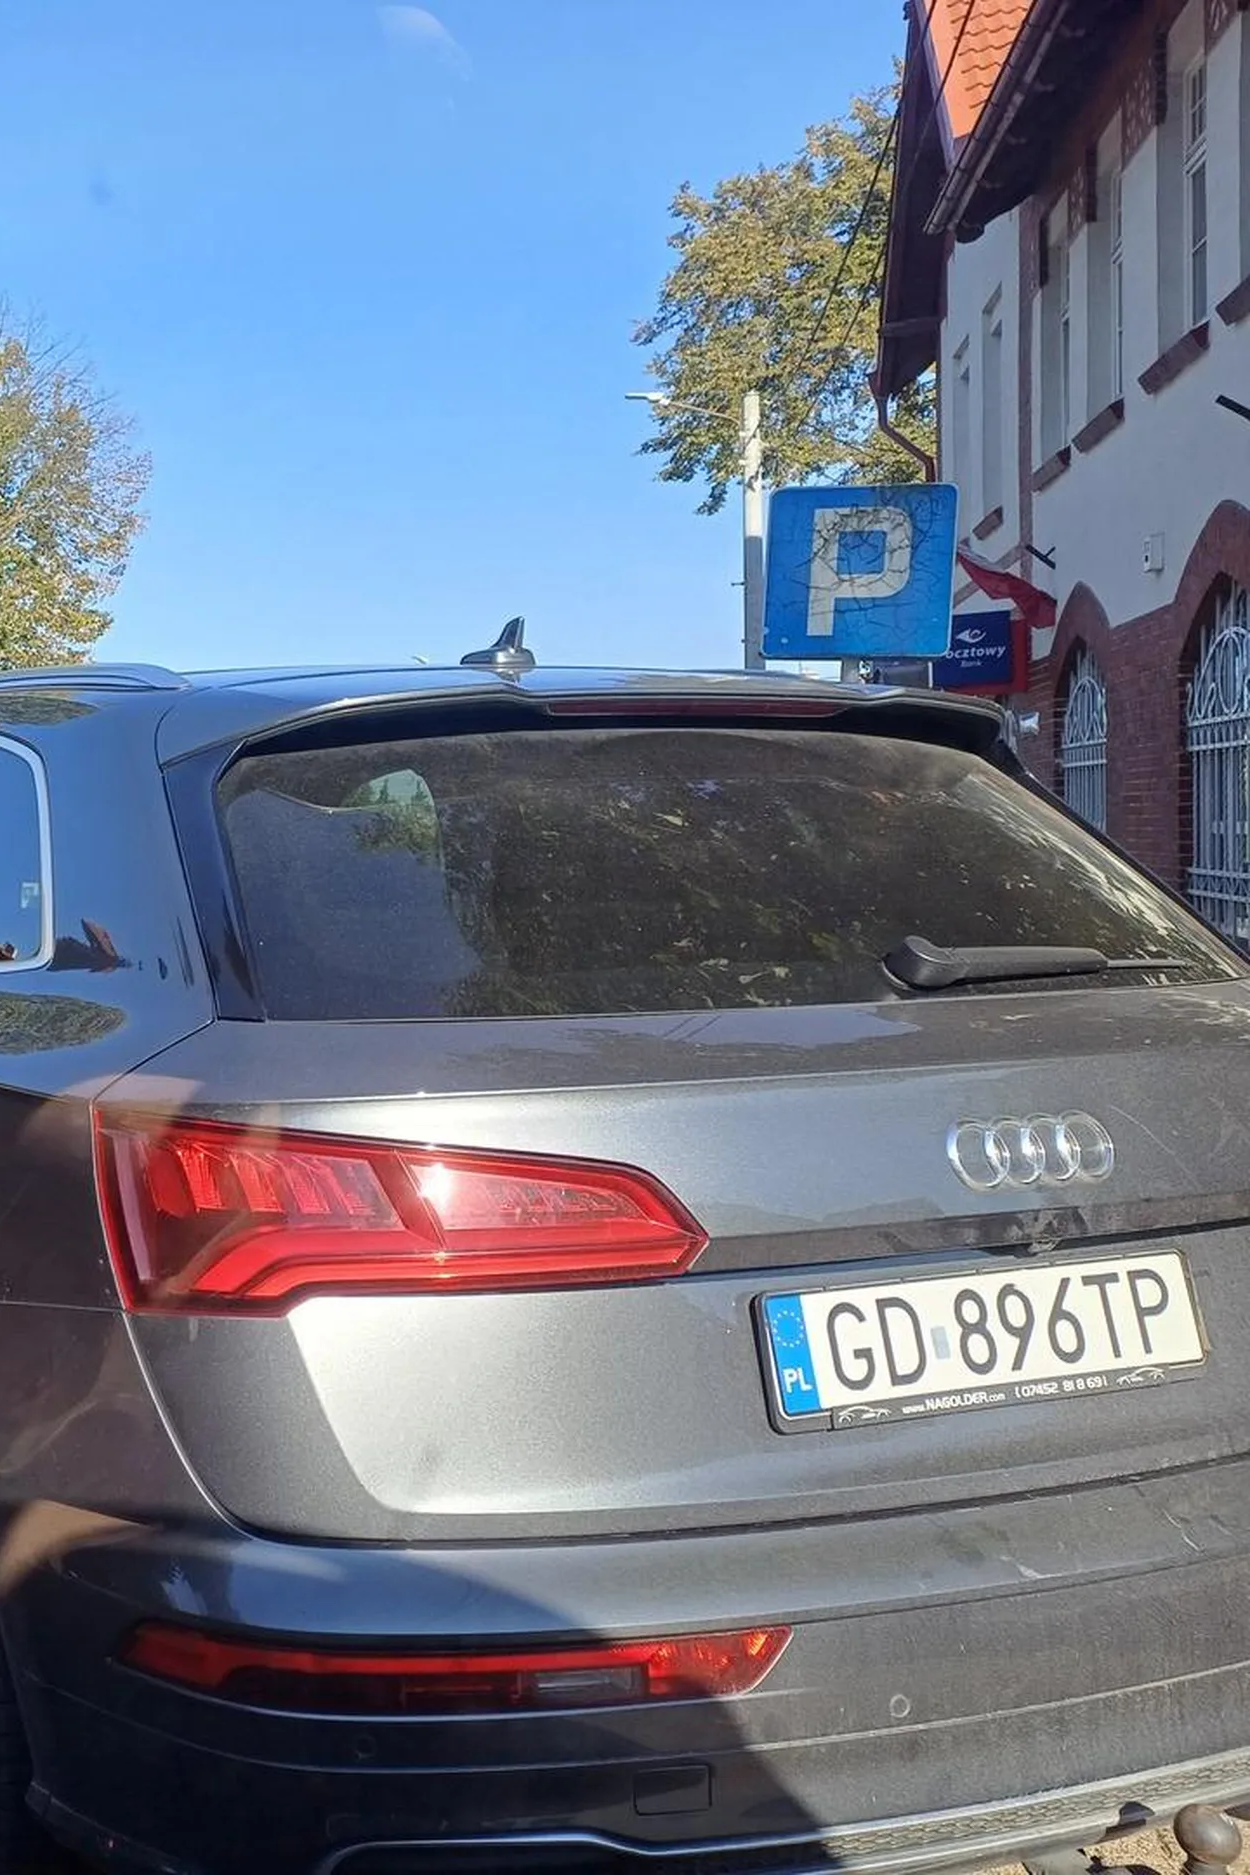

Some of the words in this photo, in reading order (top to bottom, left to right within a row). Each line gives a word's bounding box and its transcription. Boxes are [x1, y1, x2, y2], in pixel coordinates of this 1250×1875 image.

[807, 505, 913, 636] P
[946, 646, 1006, 659] ocztowy
[826, 1296, 927, 1392] GD
[953, 1268, 1170, 1376] 896TP
[783, 1367, 813, 1393] PL
[902, 1391, 1006, 1413] www.NAGOLDER.com
